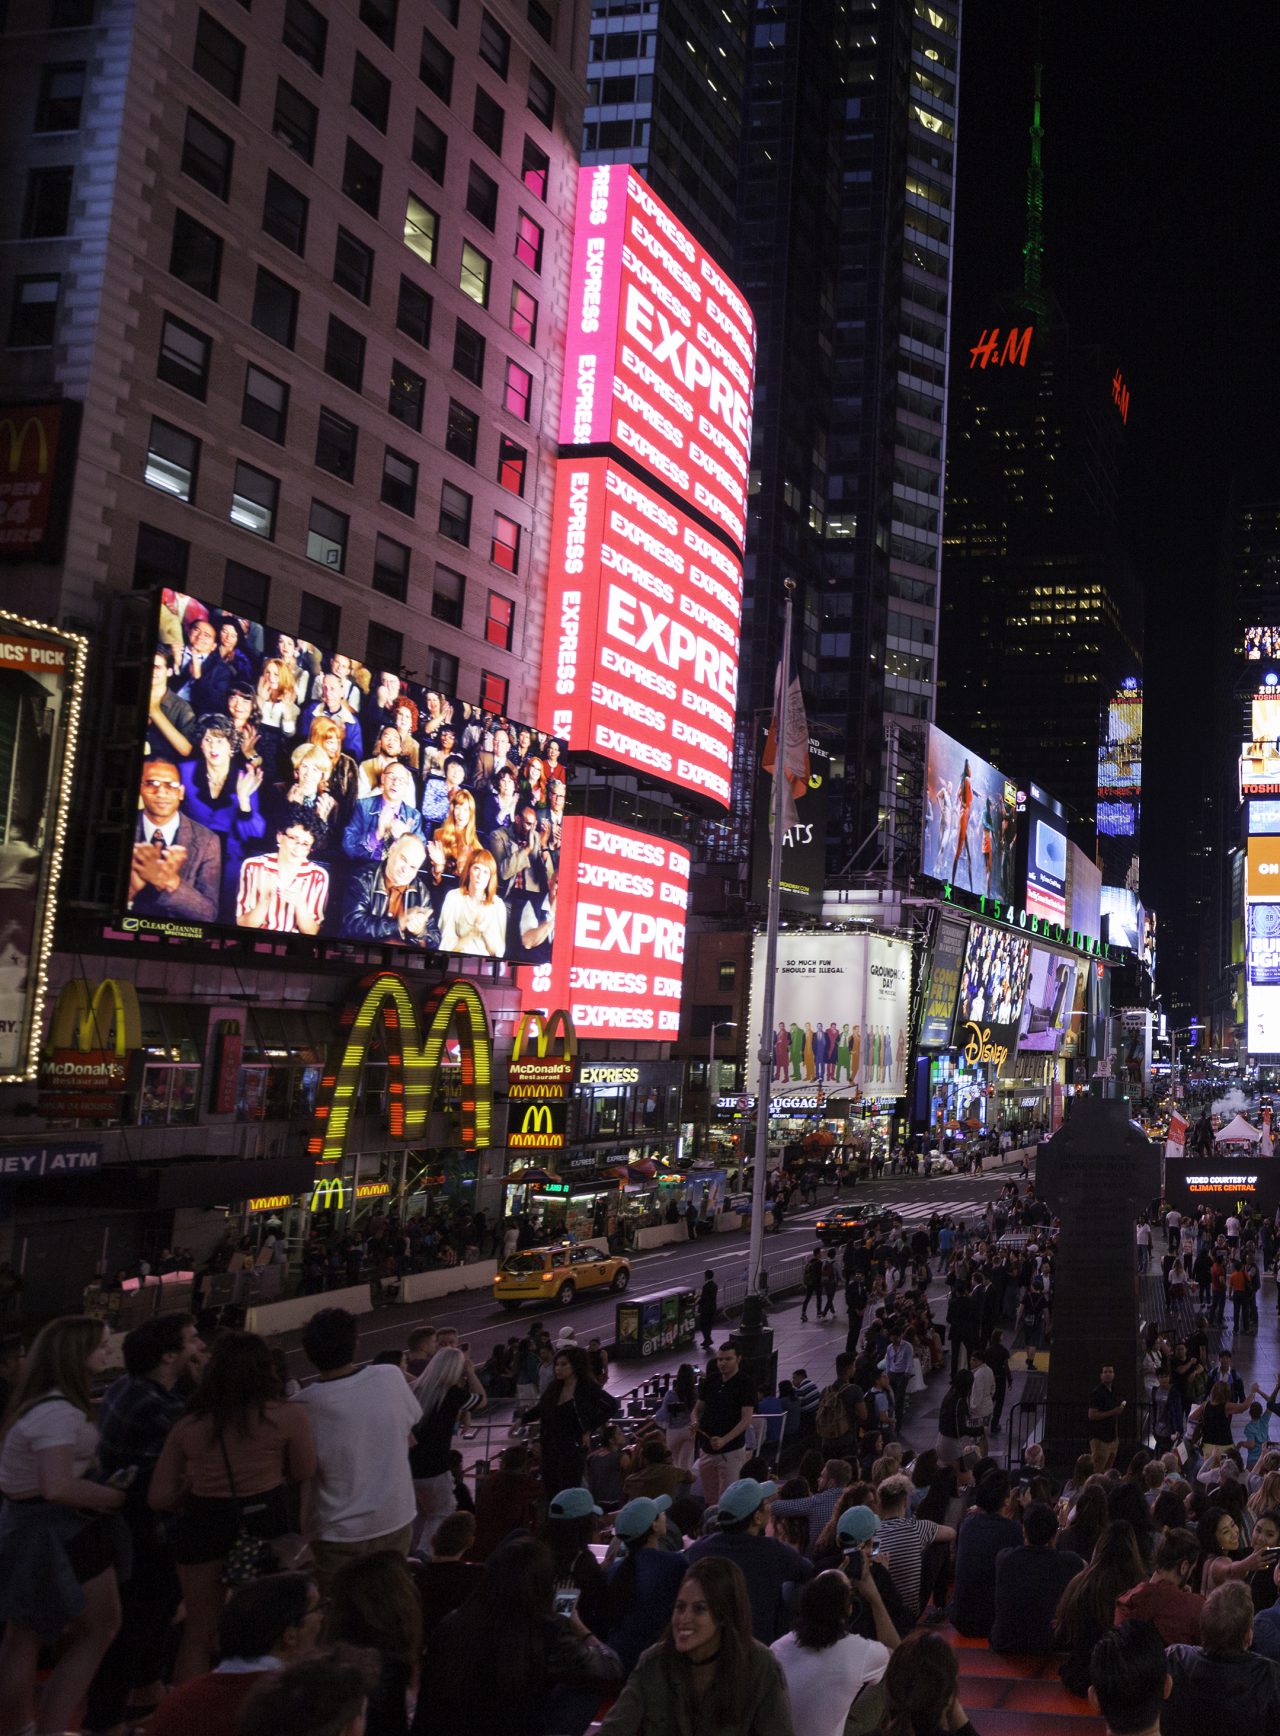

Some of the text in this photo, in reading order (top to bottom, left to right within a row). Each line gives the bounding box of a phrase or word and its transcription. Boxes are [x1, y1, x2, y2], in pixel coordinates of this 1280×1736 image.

[627, 175, 696, 264] EXPRESS
[632, 215, 701, 303] EXPRESS
[581, 237, 605, 334] EXPRESS
[622, 245, 691, 328] EXPRESS
[969, 326, 1034, 370] H&M
[622, 345, 694, 422] EXPRESS
[613, 376, 684, 449] EXPRESS
[617, 419, 689, 490] EXPRESS
[565, 472, 589, 574] EXPRESS
[606, 469, 738, 585] EXPRESS EXPRESS
[610, 511, 684, 575] EXPRESS
[601, 543, 674, 604] EXPRESS
[31, 647, 66, 666] PICK
[556, 590, 581, 695] EXPRESS
[602, 646, 676, 700] EXPRESS
[591, 682, 666, 731] EXPRESS
[596, 725, 672, 772] EXPRESS
[1016, 804, 1026, 812] LG
[584, 827, 665, 867] EXPRESS
[782, 824, 813, 848] ATS
[577, 863, 653, 898] EXPRESS
[1258, 863, 1279, 875] ON
[979, 895, 1027, 928] 1540
[1031, 914, 1110, 960] BROADWAY
[570, 967, 647, 995] EXPRESS
[882, 978, 894, 988] DAY
[572, 1004, 653, 1029] EXPRESS
[42, 1062, 124, 1076] McDonald's
[510, 1064, 571, 1074] McDonald's
[580, 1068, 639, 1083] EXPRESS
[717, 1098, 755, 1108] GIFS
[51, 1152, 97, 1169] ATM
[1186, 1176, 1258, 1184] VIDEO COURTESY OF
[1190, 1184, 1223, 1192] CLIMATE
